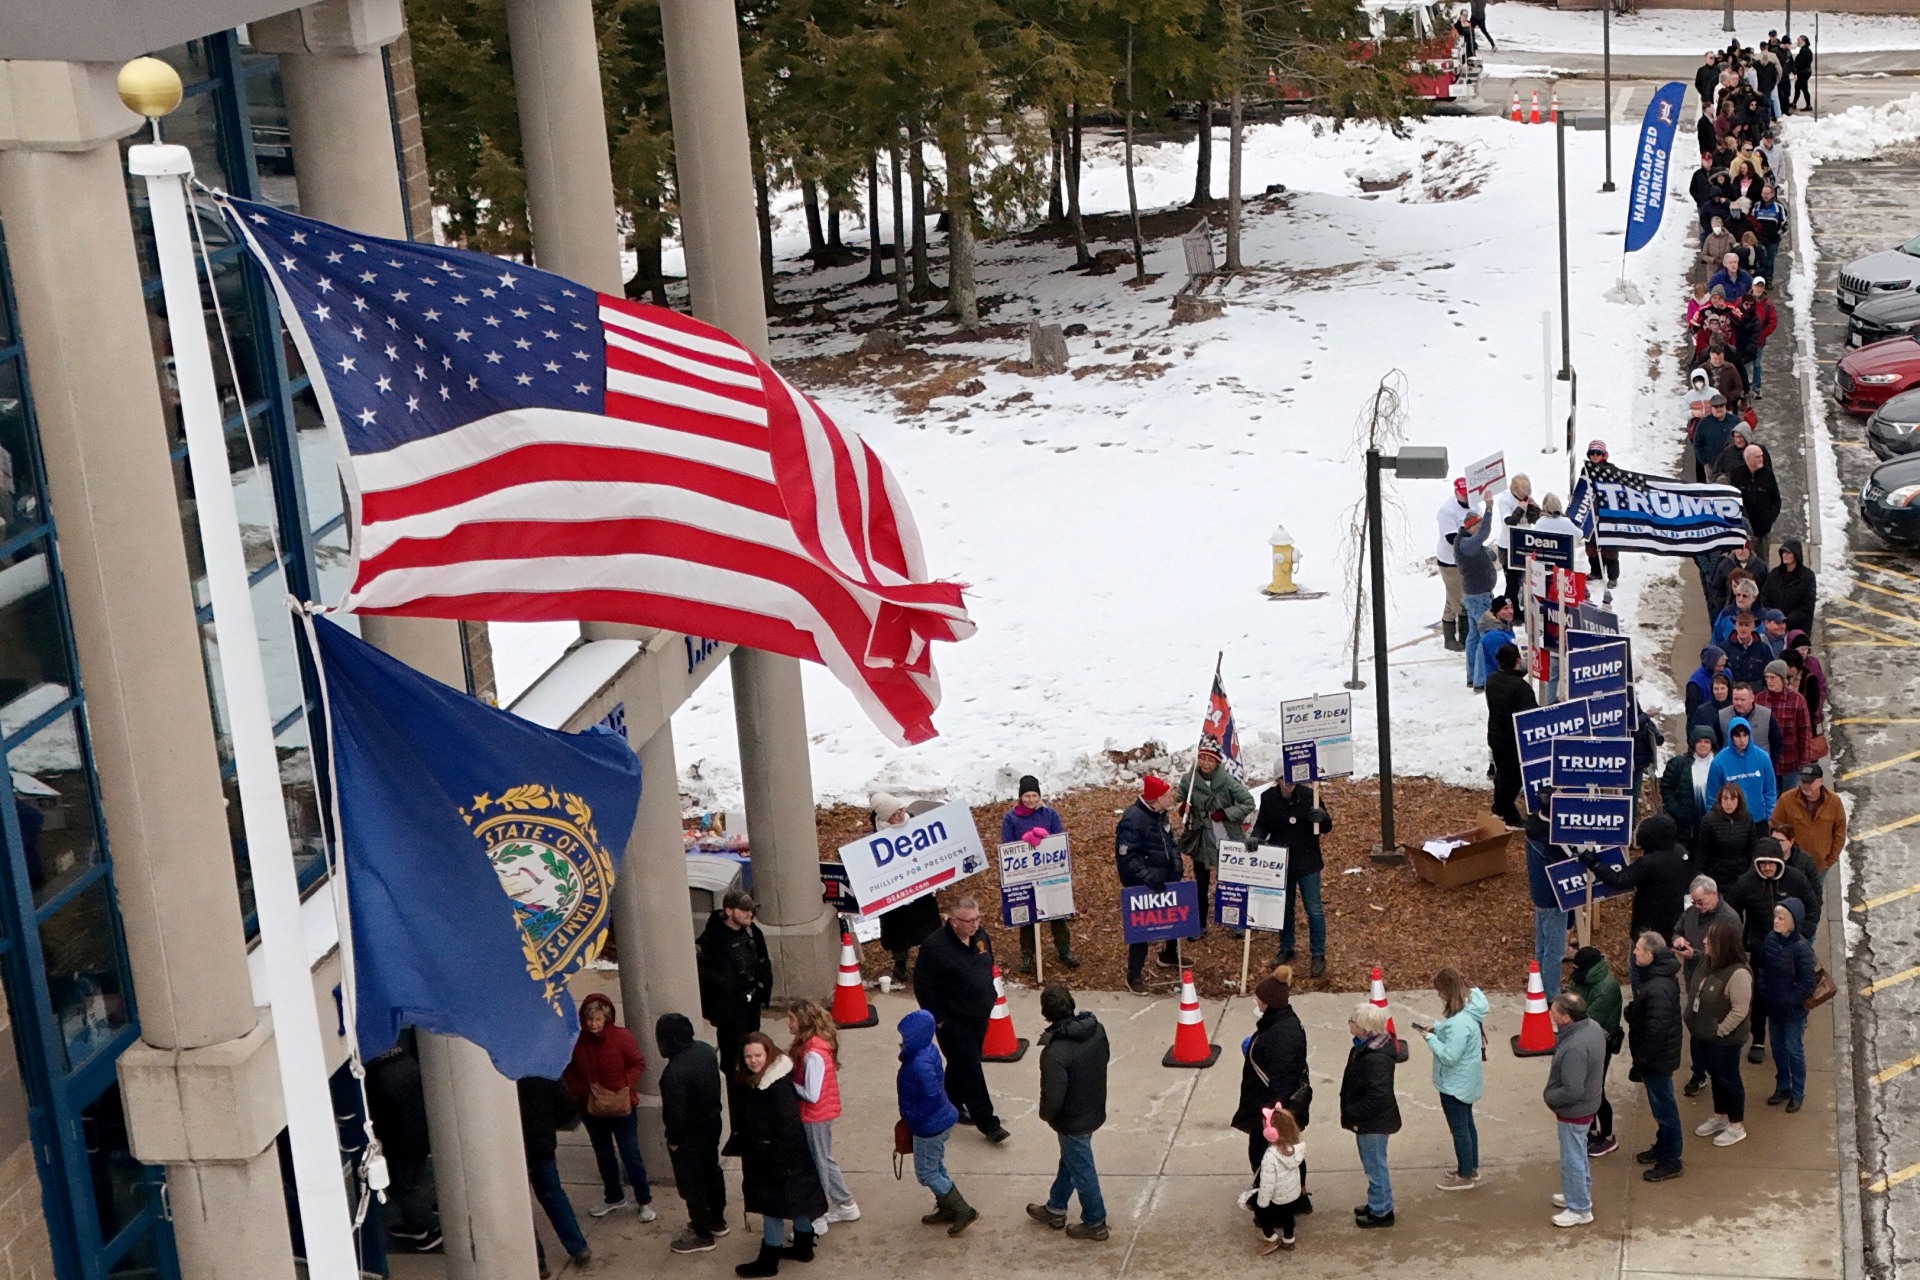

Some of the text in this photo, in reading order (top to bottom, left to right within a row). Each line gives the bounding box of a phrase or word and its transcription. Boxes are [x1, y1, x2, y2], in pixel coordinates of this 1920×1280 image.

[1633, 126, 1658, 223] HANDICAPPED
[1649, 149, 1667, 208] PARKING
[1574, 490, 1591, 524] RUM
[1595, 481, 1743, 519] TRUMP
[1524, 534, 1558, 549] Dean
[1614, 524, 1645, 534] LAW
[1651, 529, 1680, 540] AND
[1572, 660, 1622, 680] TRUMP
[1285, 708, 1348, 724] JOE BIDEN
[1592, 709, 1623, 725] UMP
[1523, 717, 1585, 741] TRUMP
[1558, 756, 1627, 769] TRUMP
[1557, 813, 1624, 827] TRUMP
[869, 821, 948, 868] Dean
[869, 874, 904, 893] PHILLIPS
[906, 866, 922, 876] FOR
[924, 846, 968, 868] PRESIDENT
[1004, 856, 1028, 871] JOE
[1032, 849, 1067, 866] BIDEN
[1220, 853, 1284, 870] JOE BIDEN
[1558, 864, 1623, 891] TRUP
[485, 823, 600, 966] STATE OF NEW HAMPSH
[886, 881, 930, 905] DEAN24.com
[1130, 891, 1178, 911] NIKKI
[1130, 905, 1190, 928] HALEY
